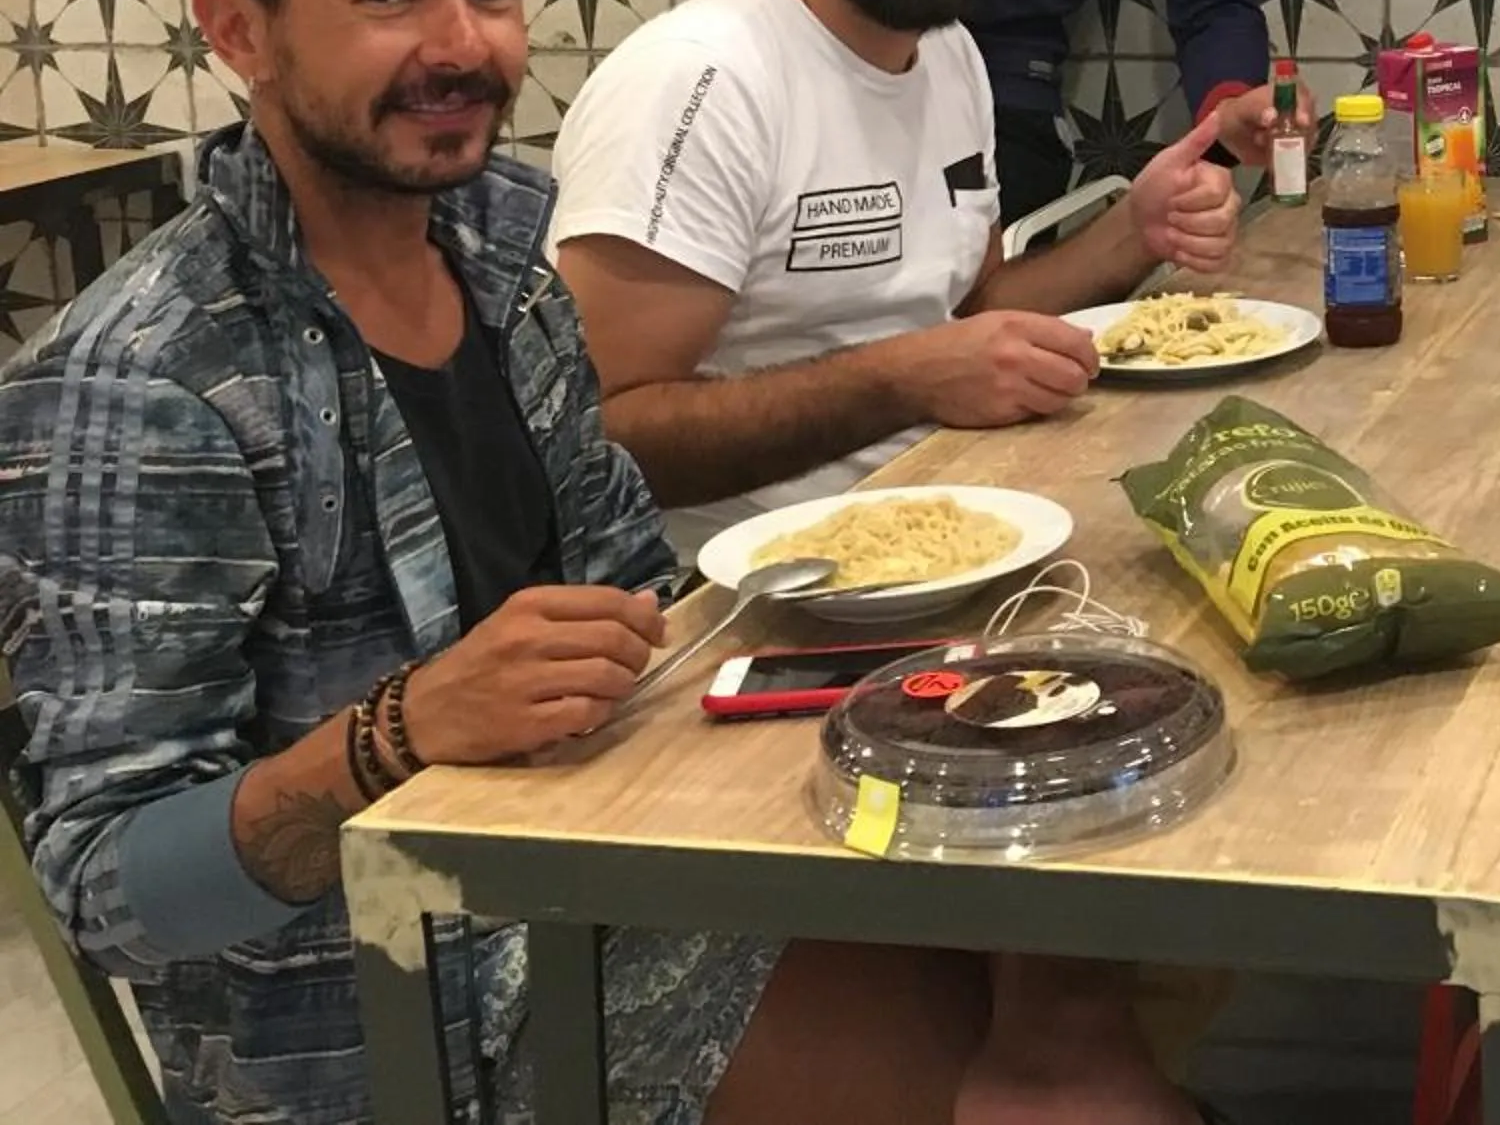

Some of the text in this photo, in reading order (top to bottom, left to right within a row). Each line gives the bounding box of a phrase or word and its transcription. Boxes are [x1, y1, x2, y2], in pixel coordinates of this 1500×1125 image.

[661, 127, 689, 176] ORIGINAL
[681, 63, 718, 126] COLLECTION
[807, 192, 897, 219] HAND MADE
[820, 237, 890, 260] PREMIUM
